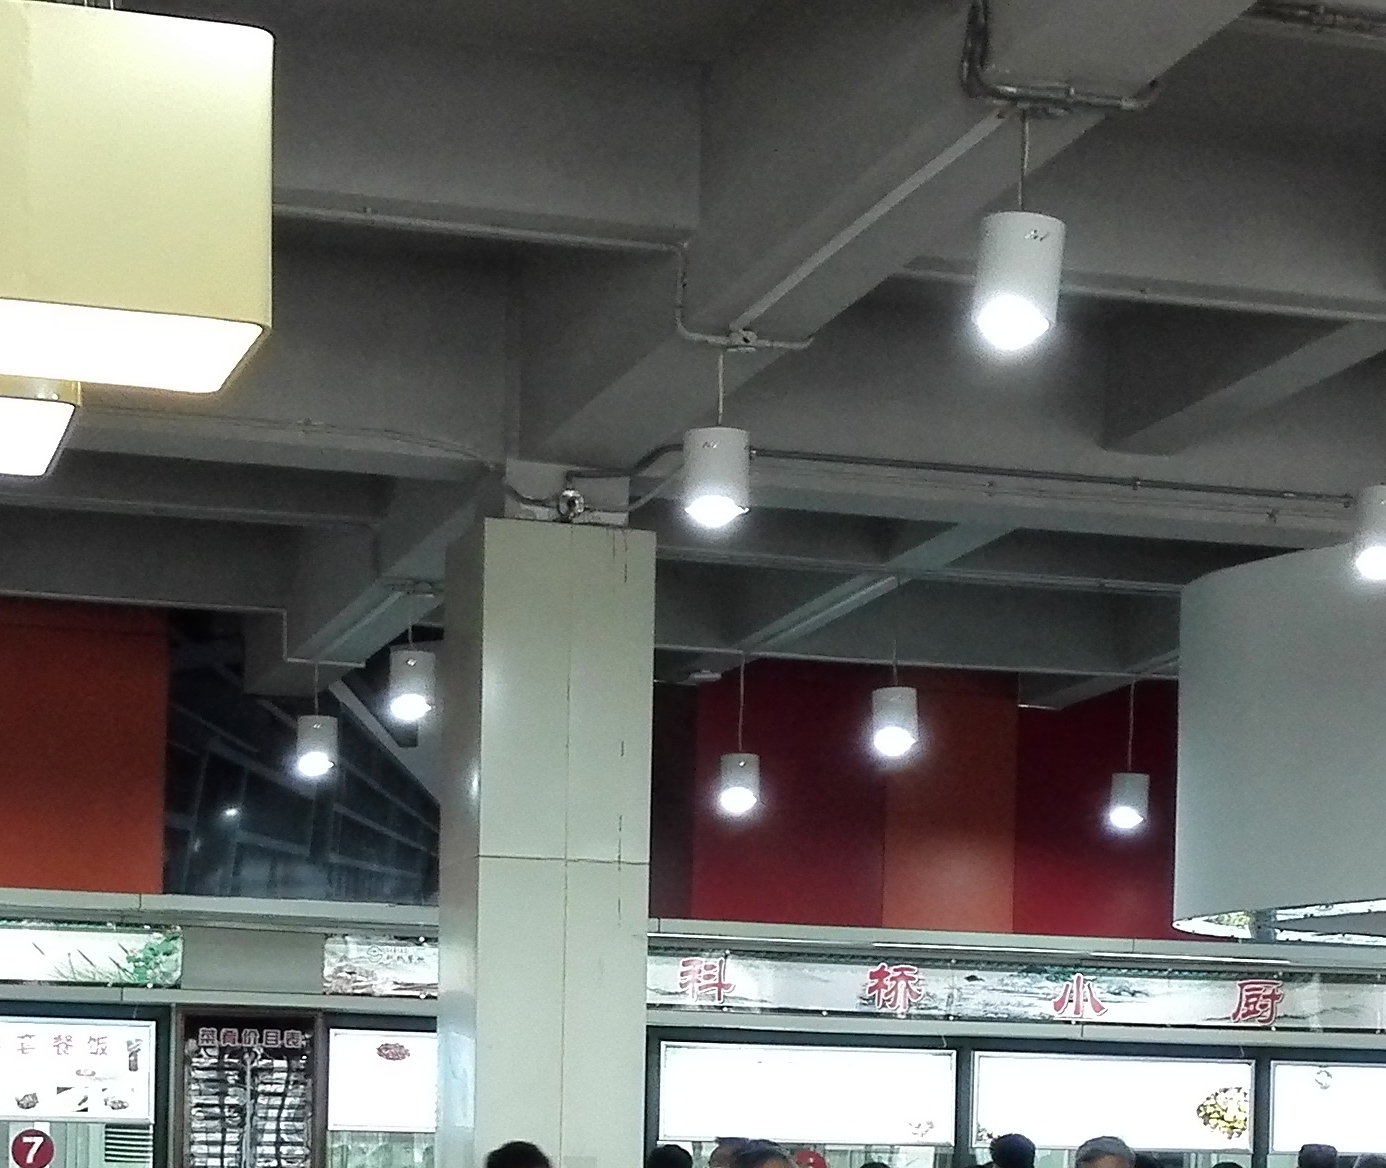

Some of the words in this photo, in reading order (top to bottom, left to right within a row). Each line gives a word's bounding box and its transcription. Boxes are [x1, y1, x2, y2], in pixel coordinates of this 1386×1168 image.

[678, 957, 1284, 1025] 科桥小厨
[198, 1027, 302, 1049] 菜肴价目表
[22, 1136, 45, 1164] 7
